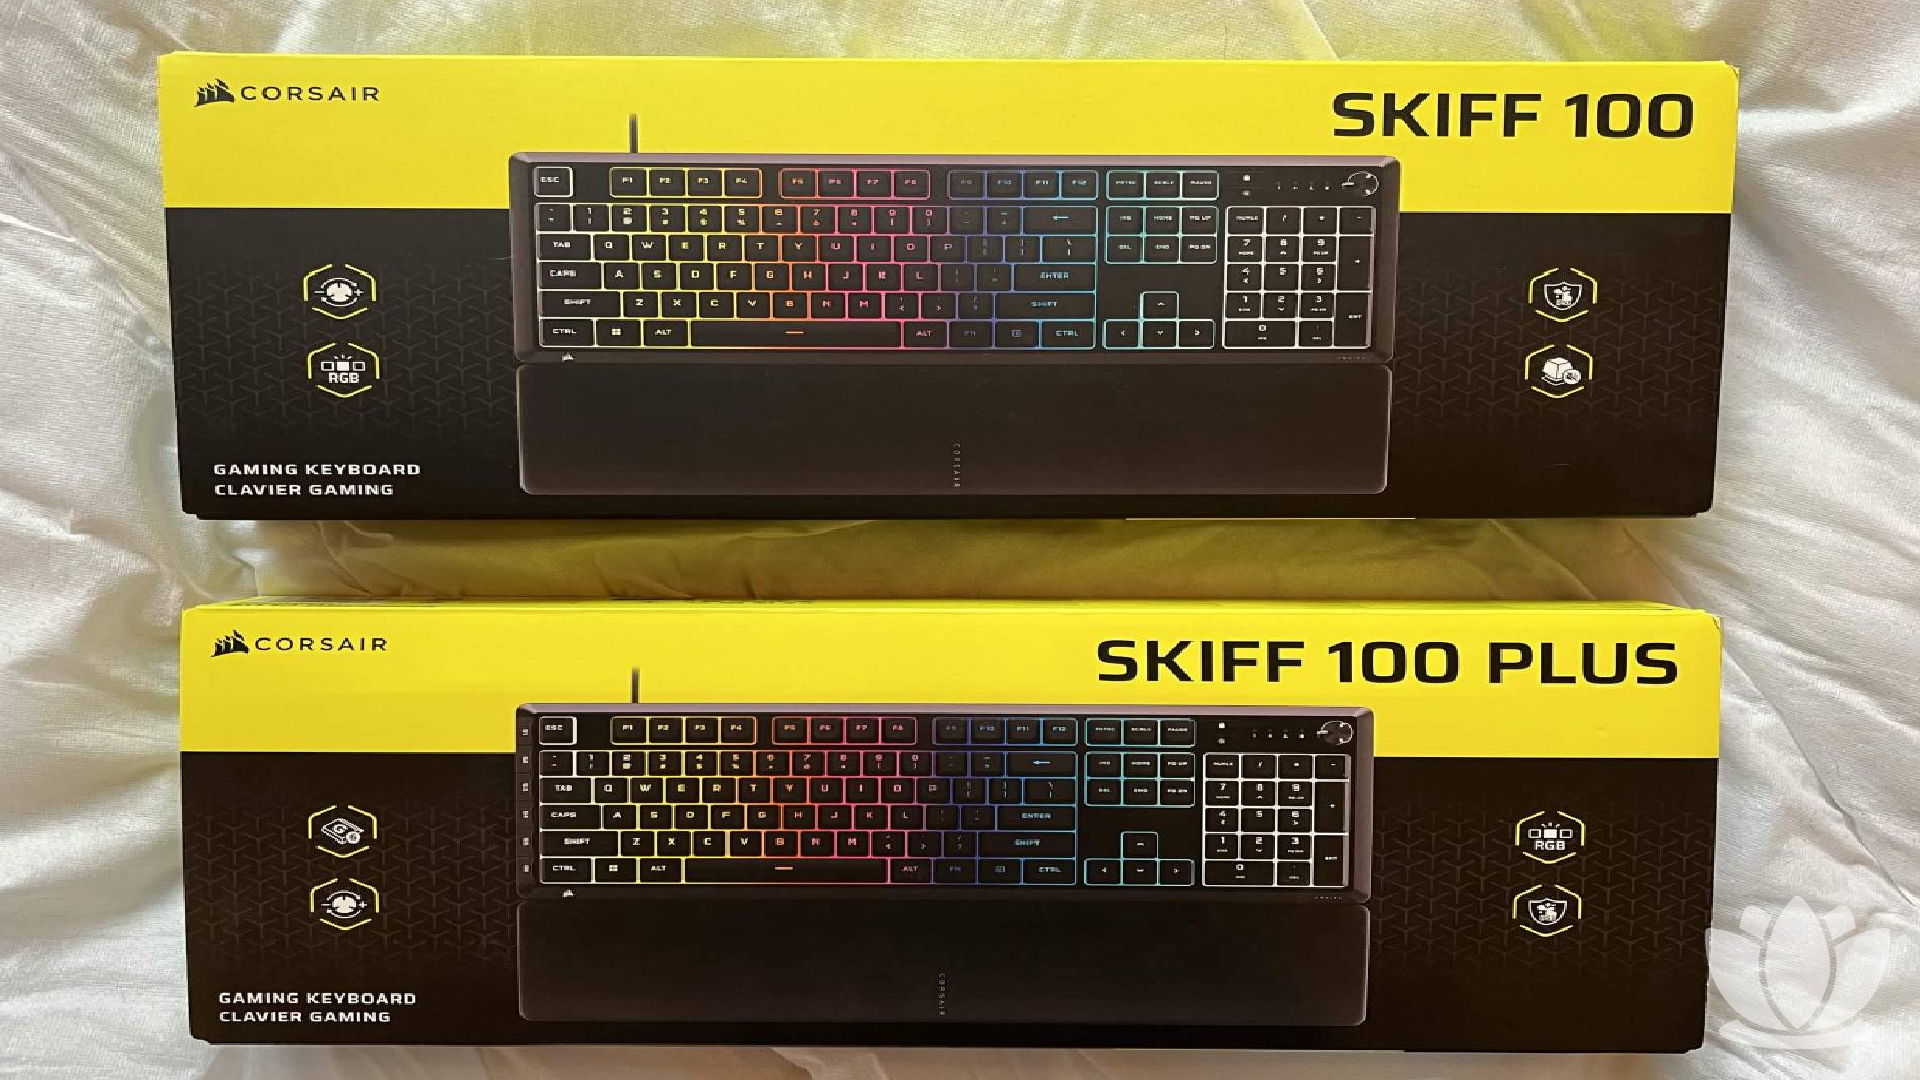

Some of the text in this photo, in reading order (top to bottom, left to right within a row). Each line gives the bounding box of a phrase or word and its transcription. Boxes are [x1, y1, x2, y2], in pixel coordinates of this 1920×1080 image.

[240, 85, 380, 101] CORSAIR
[1333, 92, 1694, 138] SKIFF 100
[622, 176, 633, 184] F1
[605, 241, 613, 249] Q
[640, 241, 654, 250] W
[681, 241, 689, 250] E
[718, 242, 726, 250] R
[756, 242, 765, 250] T
[794, 242, 804, 250] Y
[830, 242, 841, 251] U
[1242, 238, 1251, 246] 7
[1279, 238, 1288, 246] 8
[1317, 238, 1326, 246] 9
[943, 243, 953, 251] P
[614, 269, 624, 278] A
[653, 269, 663, 279] S
[691, 269, 700, 279] D
[729, 270, 737, 279] F
[766, 270, 774, 279] G
[803, 270, 813, 279] H
[842, 270, 850, 280] J
[915, 270, 924, 280] L
[635, 298, 644, 306] Z
[672, 298, 682, 306] X
[710, 298, 719, 307] C
[327, 371, 361, 385] RGB
[213, 464, 421, 475] GAMING KEYBOARD
[214, 484, 394, 496] CLAVIER GAMING
[254, 636, 388, 651] CORSAIR
[1097, 639, 1678, 685] SKIFF 100 PLUS
[554, 784, 573, 792] TAB
[603, 783, 613, 793] Q
[639, 783, 652, 792] W
[677, 783, 686, 793] E
[712, 783, 722, 792] R
[749, 783, 757, 792] T
[784, 783, 794, 793] Y
[821, 783, 829, 793] U
[612, 811, 622, 819] A
[650, 811, 658, 819] S
[685, 811, 695, 819] D
[721, 810, 731, 819] F
[794, 811, 802, 819] H
[830, 811, 839, 819] J
[866, 811, 874, 819] K
[902, 811, 909, 819] L
[563, 837, 591, 845] SHIFT
[632, 837, 641, 846] Z
[667, 837, 675, 846] X
[704, 837, 712, 846] C
[740, 837, 749, 846] V
[776, 837, 785, 846] B
[847, 837, 857, 846] M
[1015, 838, 1041, 846] SHIFT
[1533, 839, 1567, 852] RGB
[218, 992, 416, 1004] GAMING KEYBOARD
[219, 1011, 391, 1023] CLAVIER GAMING
